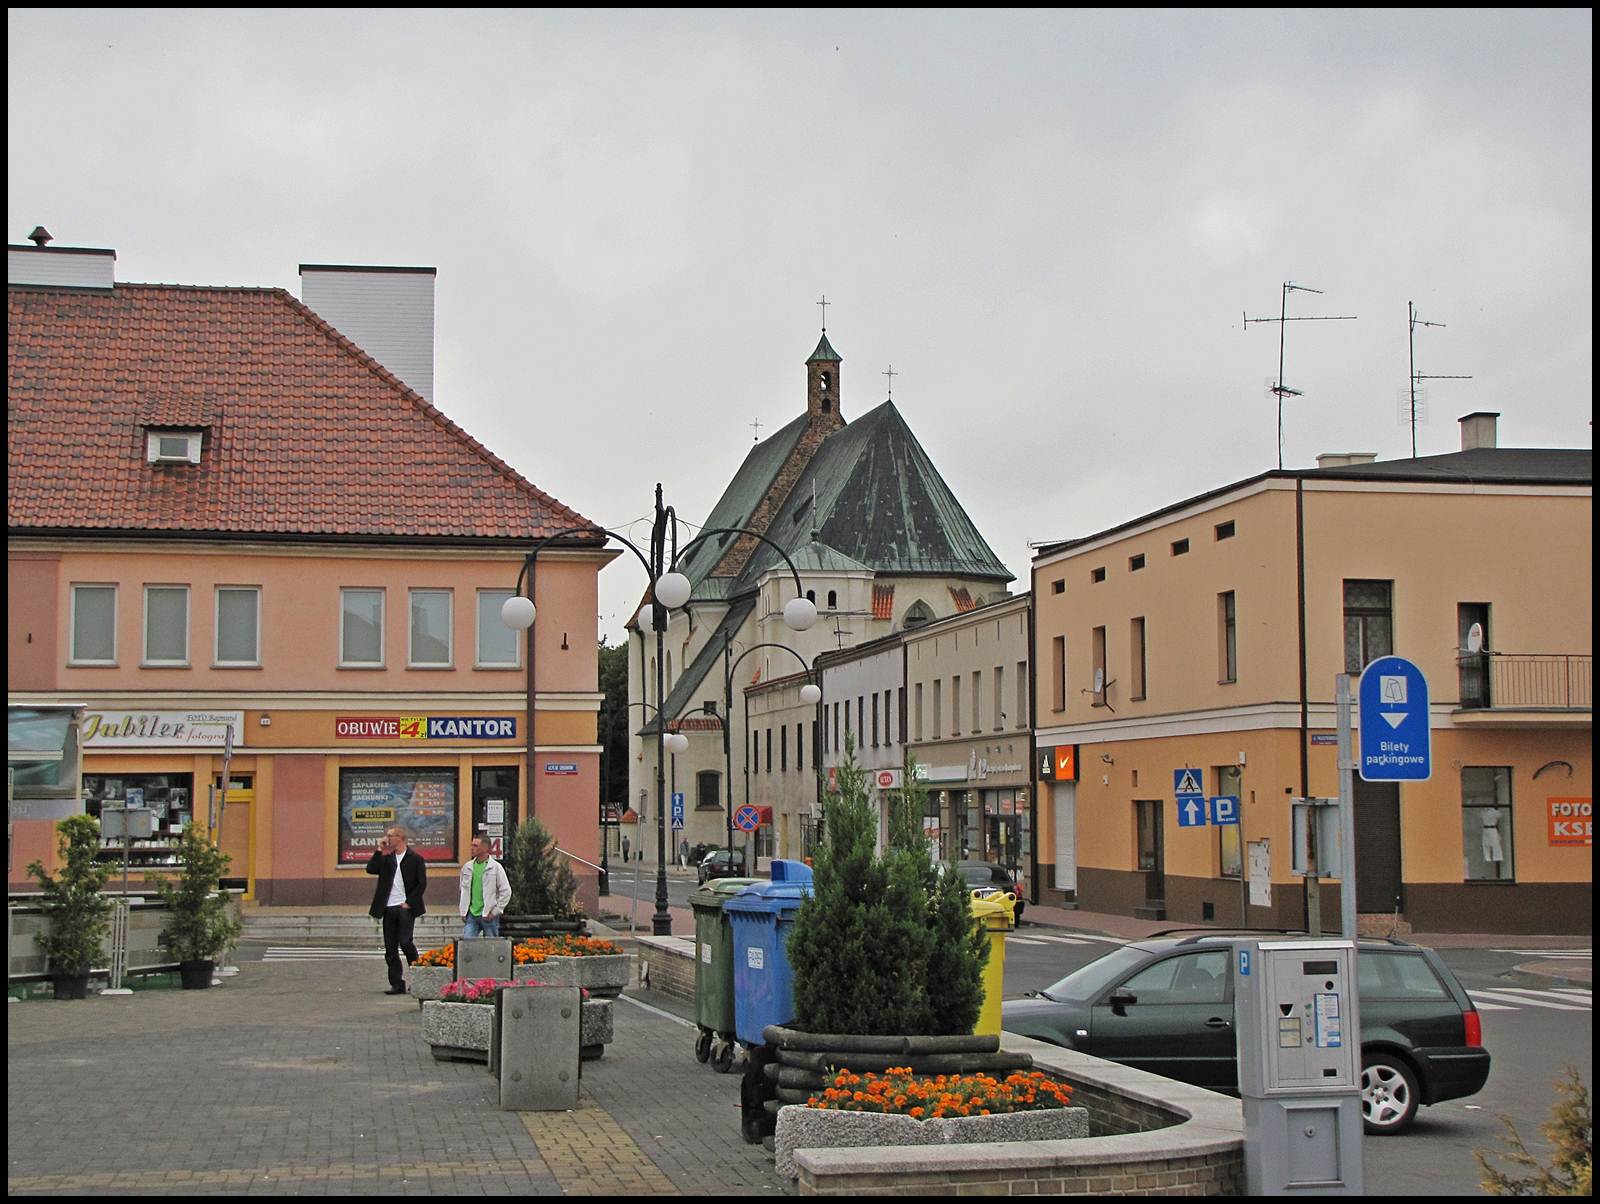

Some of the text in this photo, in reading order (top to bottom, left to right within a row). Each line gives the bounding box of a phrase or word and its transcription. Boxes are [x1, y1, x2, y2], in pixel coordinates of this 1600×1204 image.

[83, 714, 184, 741] Jubiler
[338, 720, 398, 735] OBUWIE
[400, 720, 419, 737] 4
[430, 720, 513, 735] KANTOR
[1380, 741, 1410, 753] Bilety
[1366, 755, 1424, 766] parkingowe
[673, 806, 682, 817] P
[1215, 799, 1232, 822] P
[1552, 803, 1592, 817] FOTO
[490, 837, 503, 859] 4
